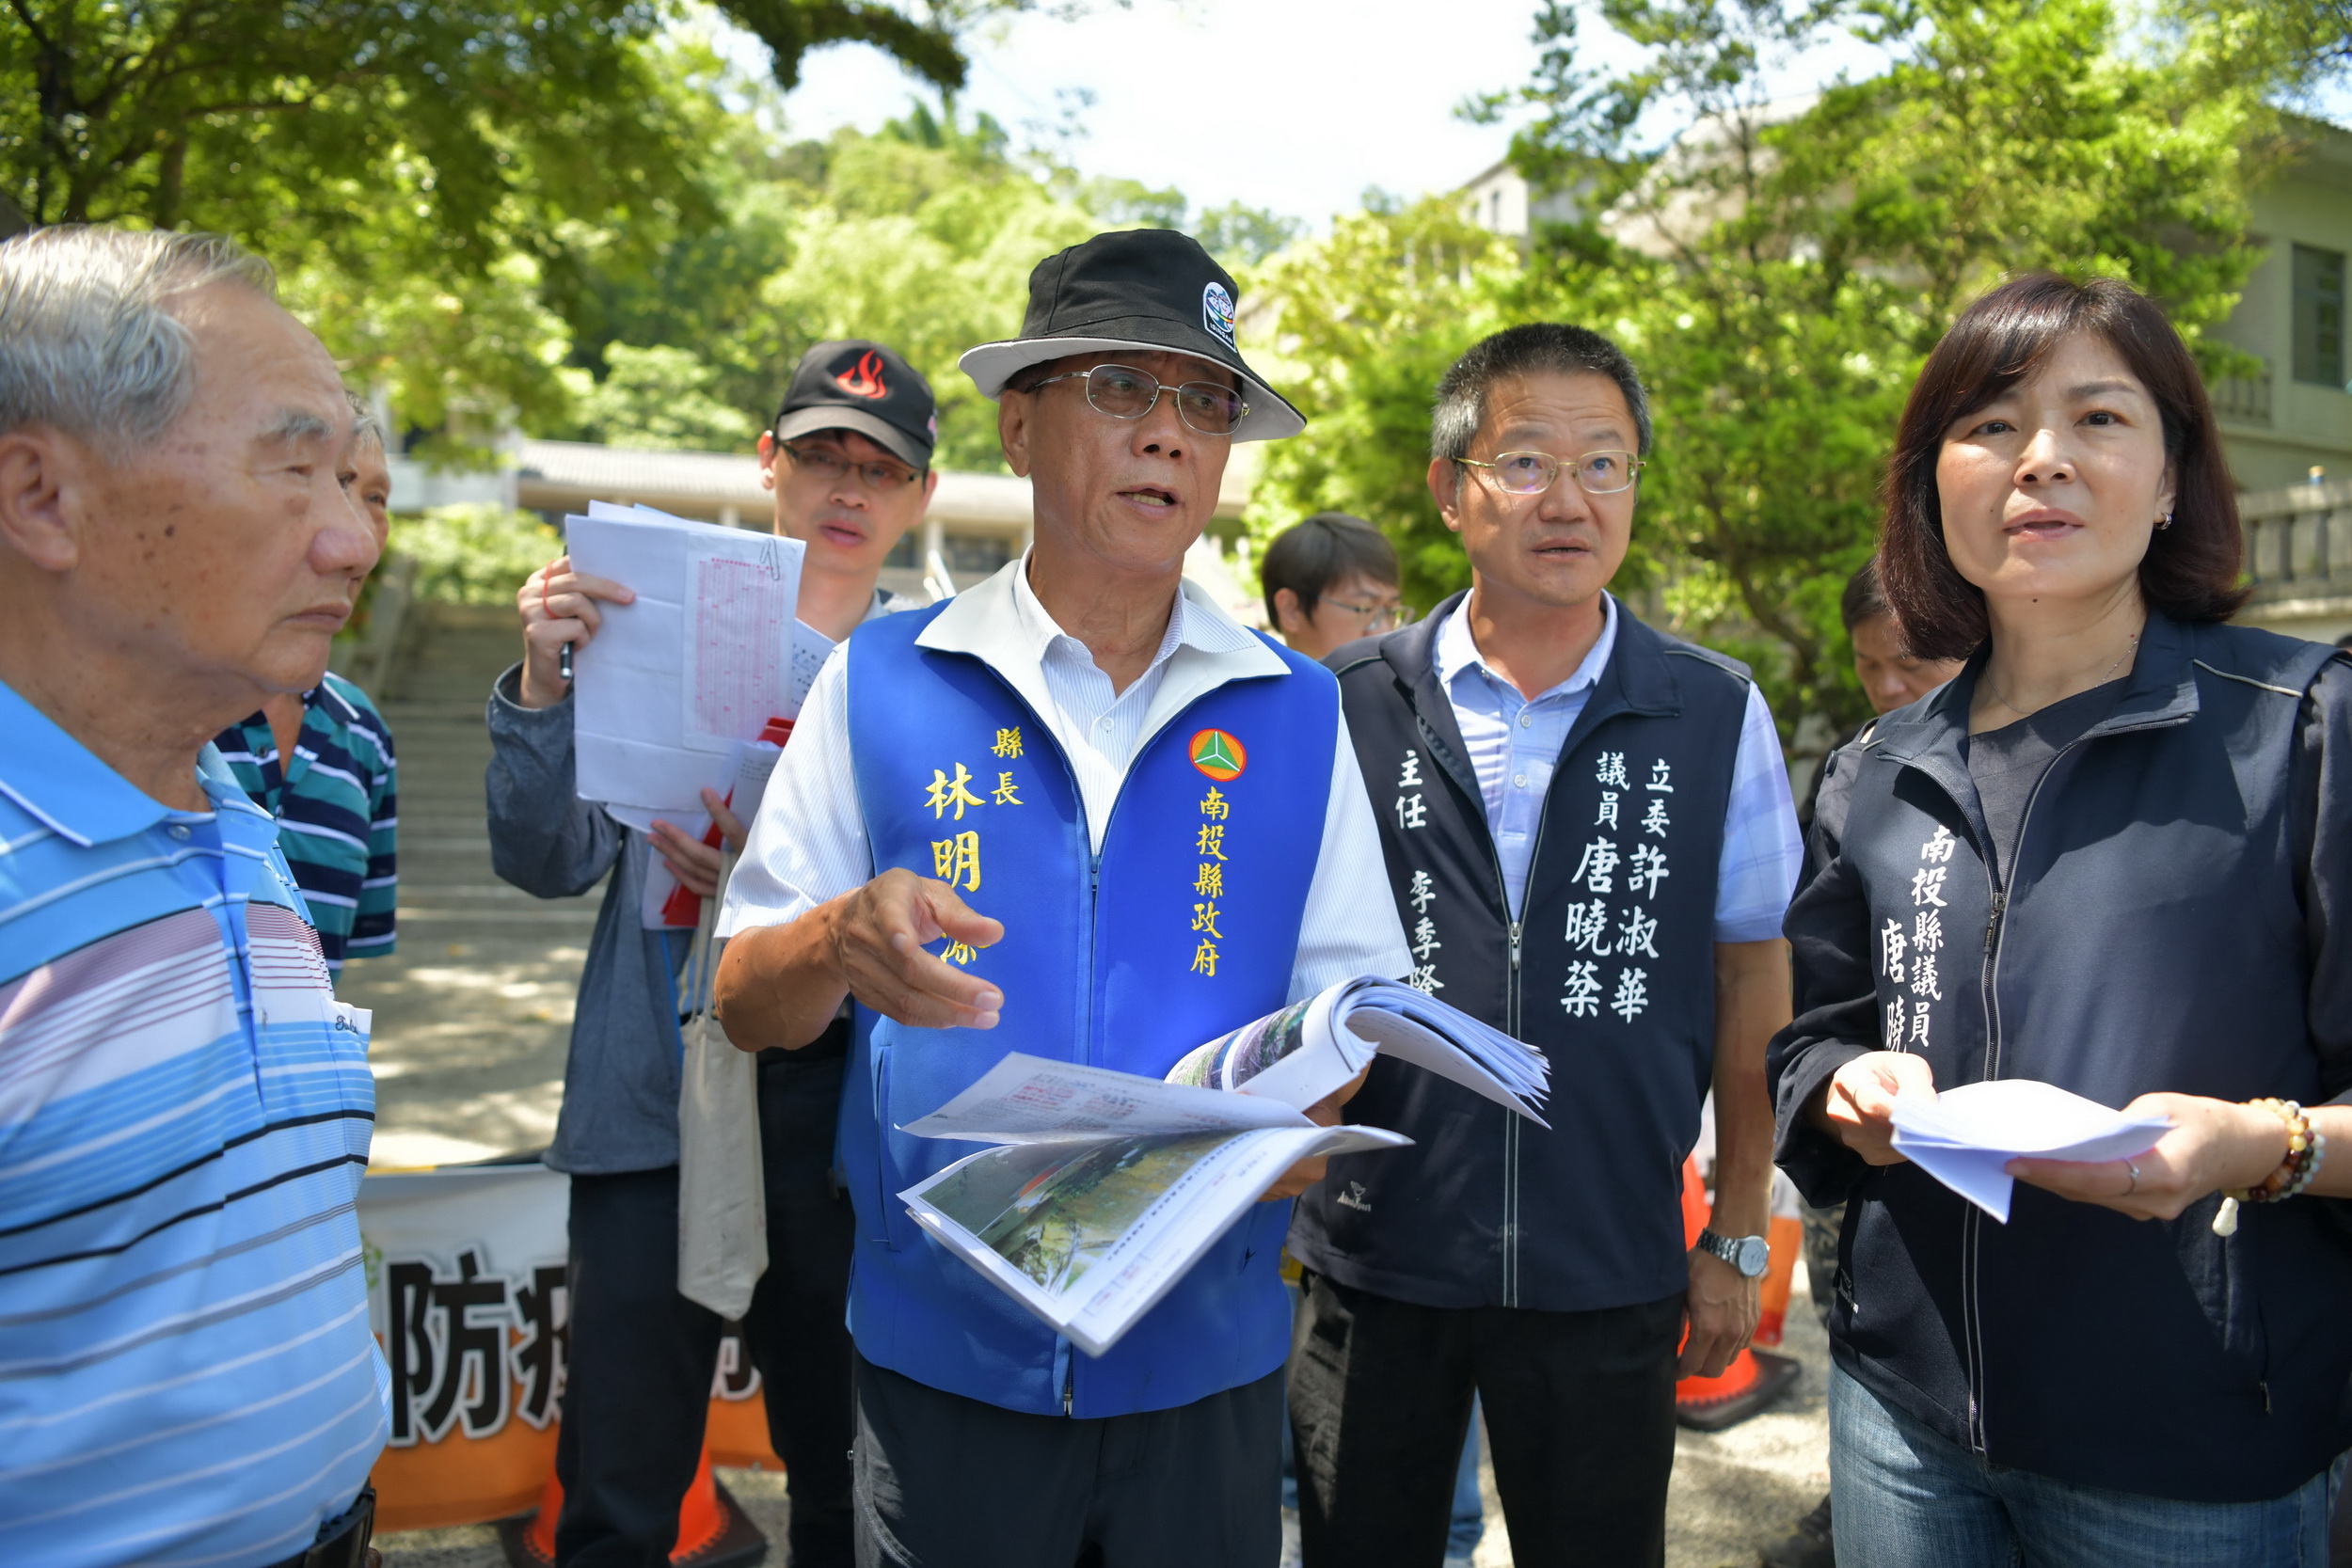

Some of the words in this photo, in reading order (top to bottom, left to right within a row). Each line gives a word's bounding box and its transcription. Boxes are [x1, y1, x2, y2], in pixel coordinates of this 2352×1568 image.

[991, 726, 1024, 806] 縣長
[1395, 750, 1427, 830] 主任
[1191, 785, 1230, 977] 南投縣政府
[1909, 824, 1957, 1048] 南投縣議員
